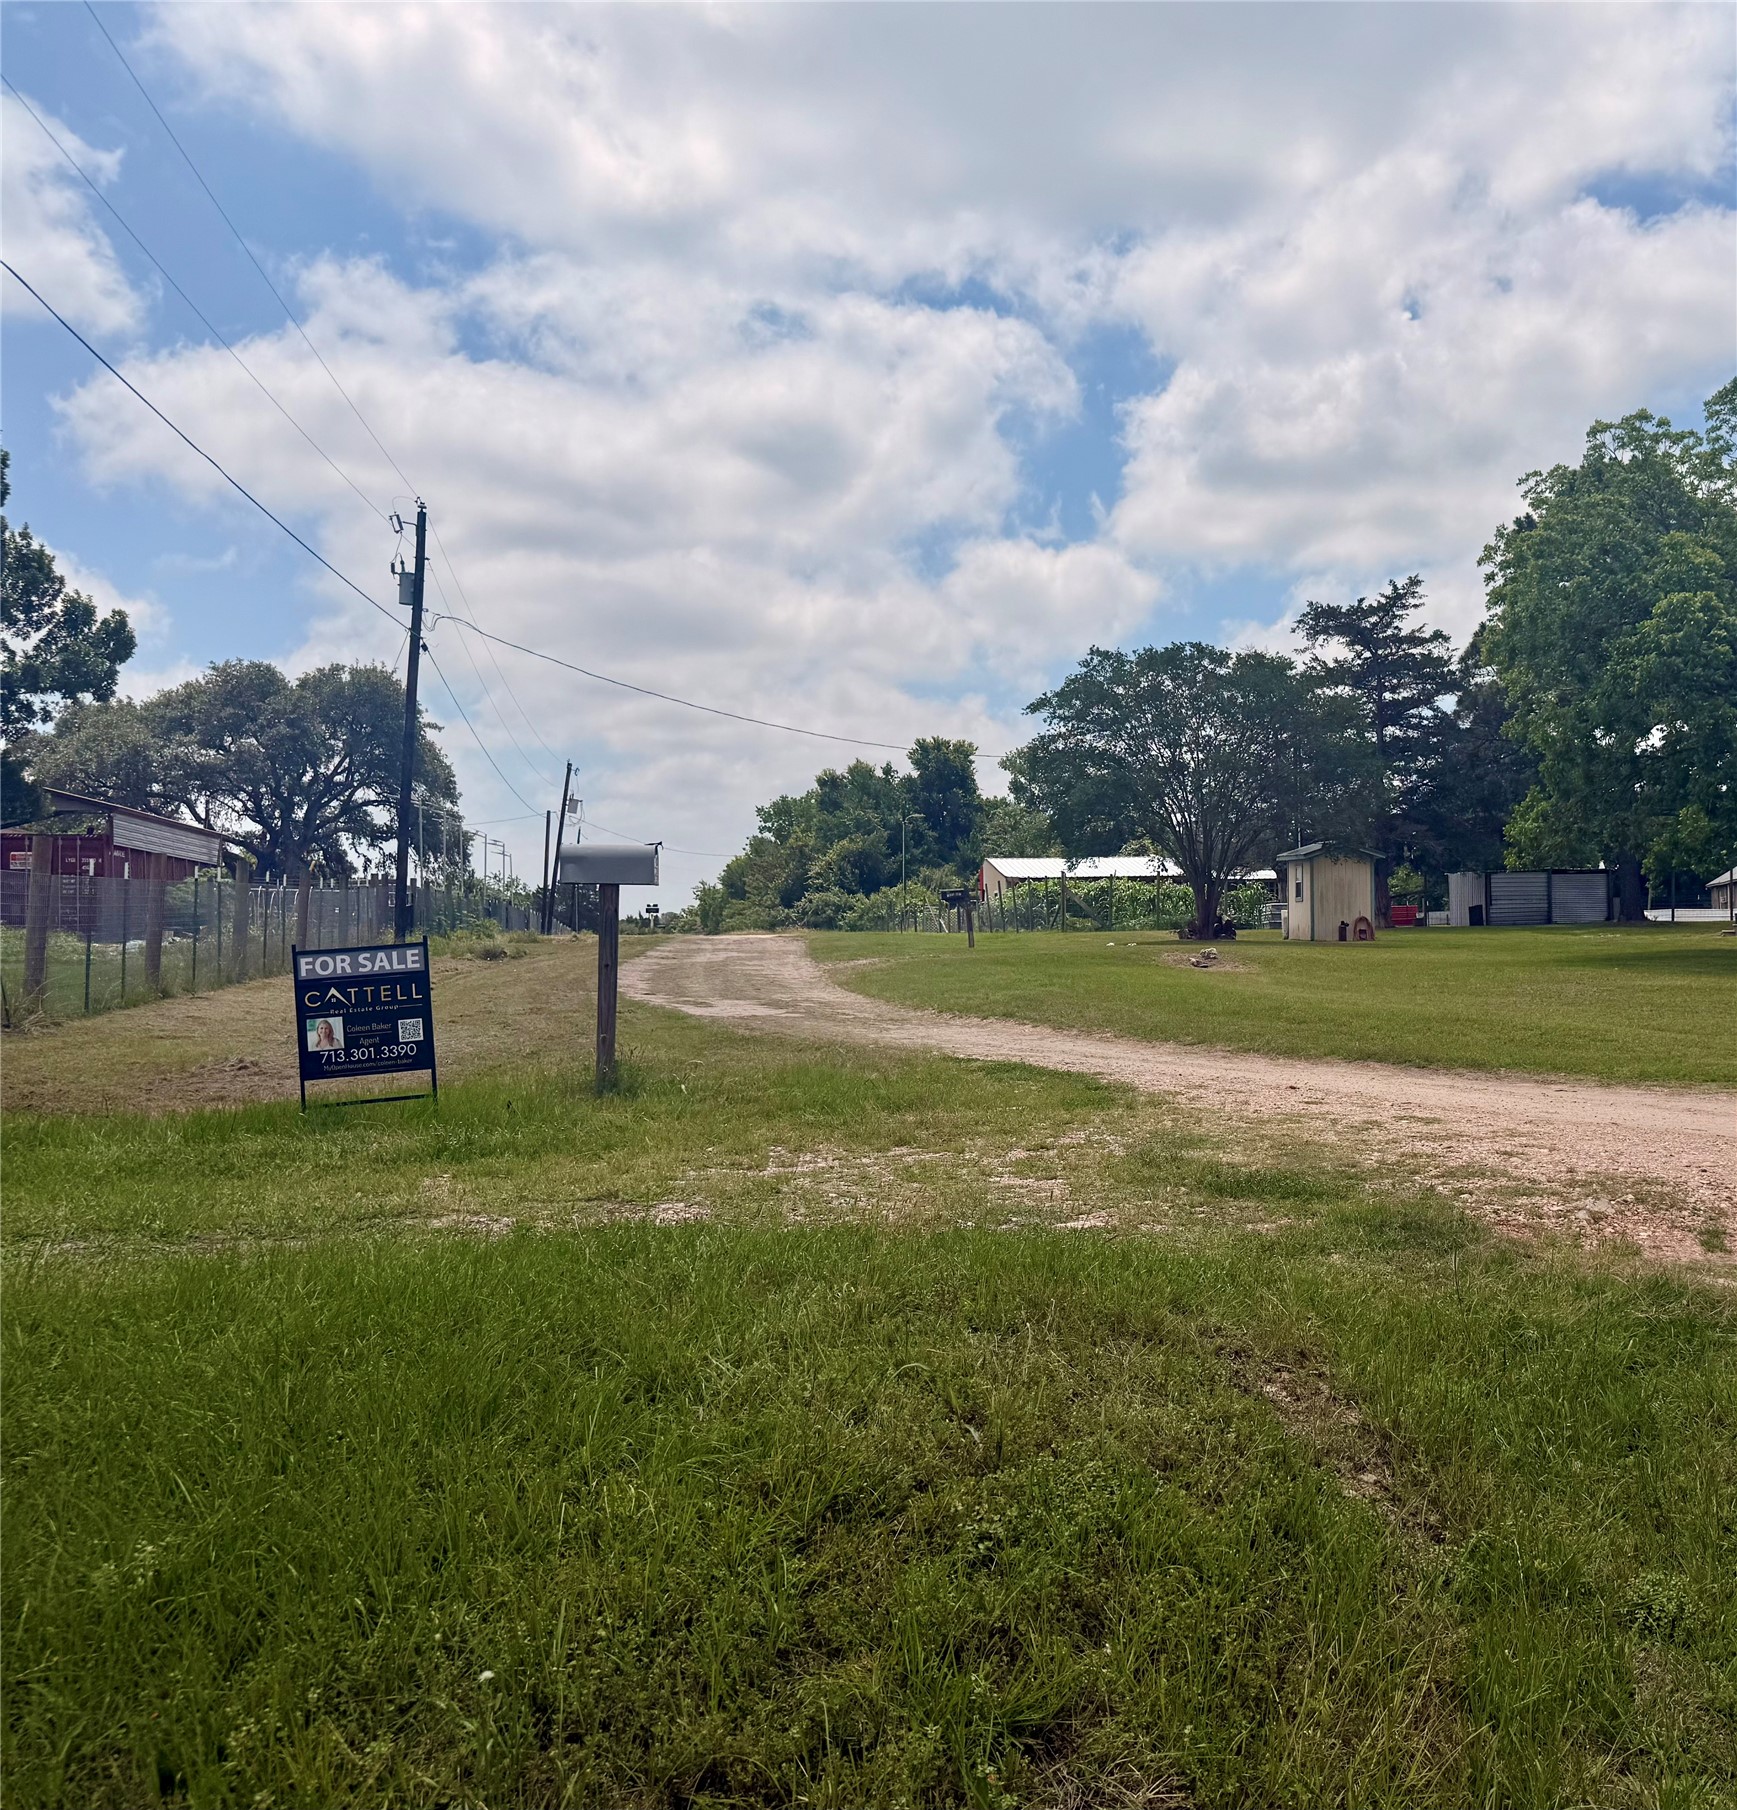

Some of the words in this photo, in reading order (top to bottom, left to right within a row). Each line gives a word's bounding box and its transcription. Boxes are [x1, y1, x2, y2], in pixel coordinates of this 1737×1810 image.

[300, 955, 352, 977] FOR
[358, 949, 420, 972] SALE
[304, 983, 423, 1007] CATTELL
[346, 1024, 371, 1032] Coleen
[371, 1022, 392, 1031] Baker
[359, 1037, 380, 1046] Agent
[320, 1043, 417, 1064] 713.301.3390
